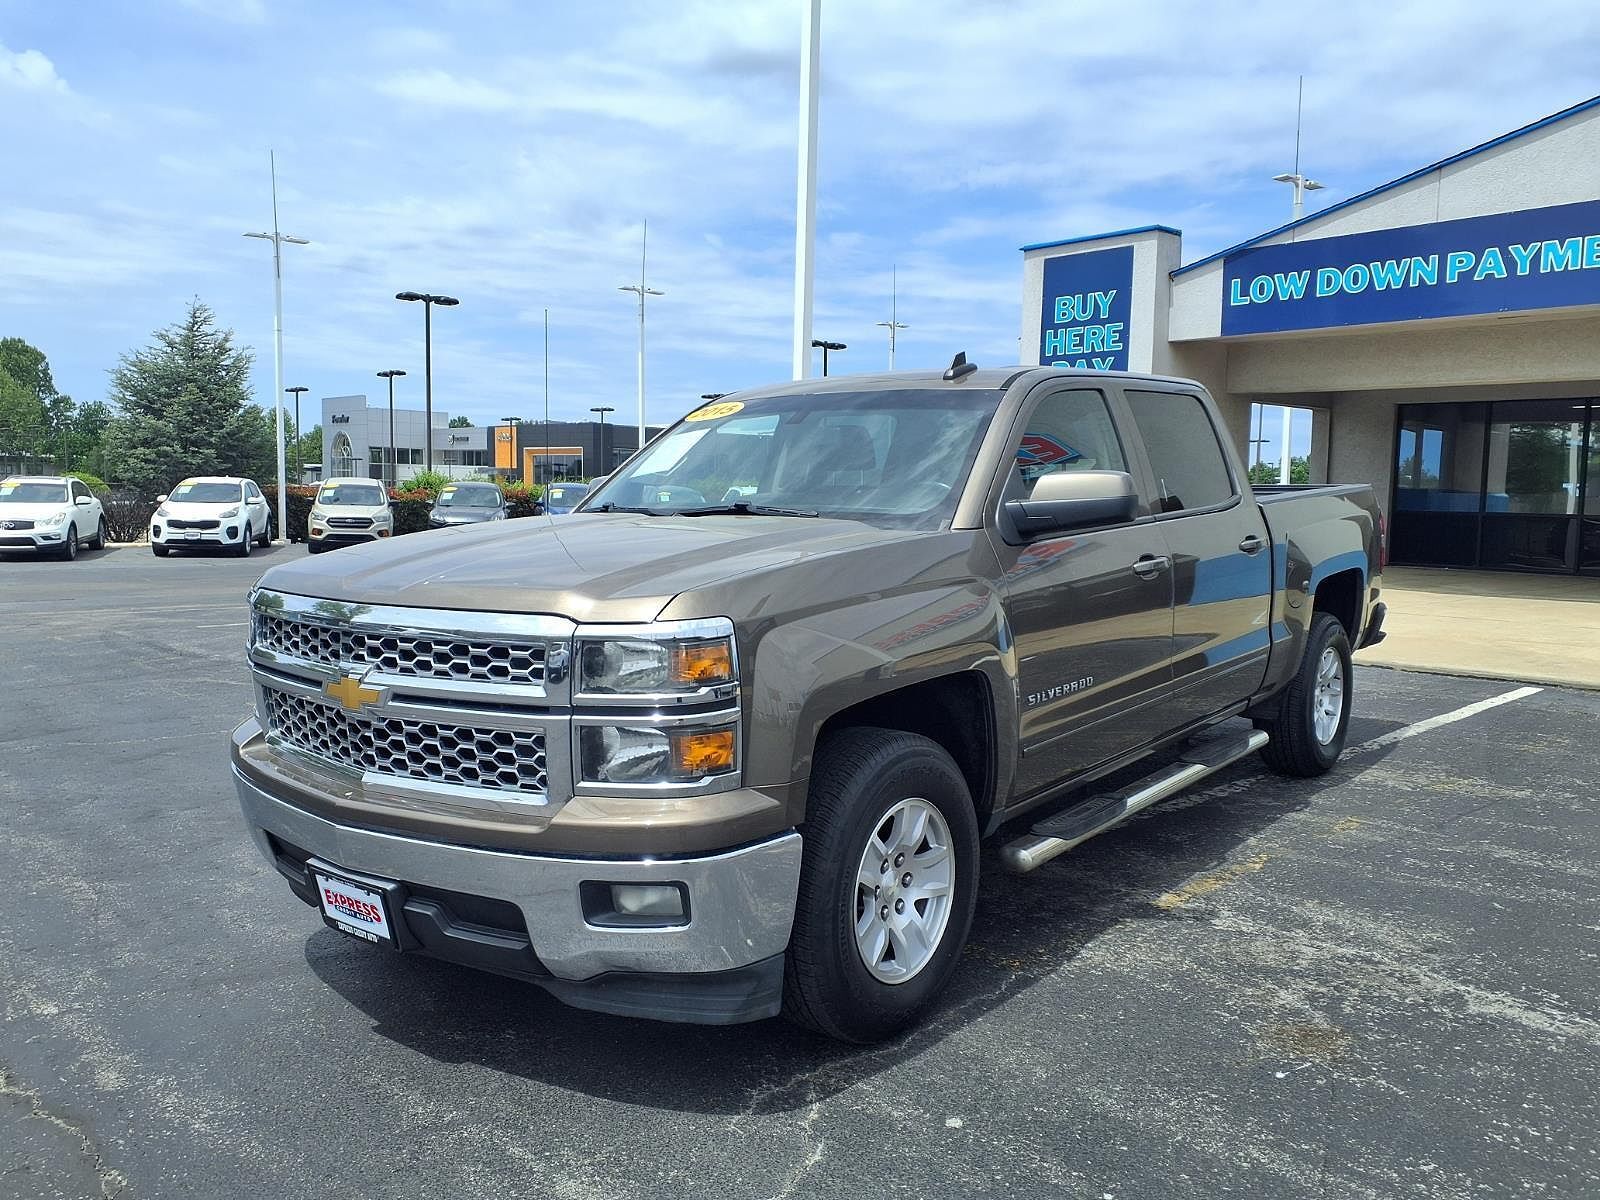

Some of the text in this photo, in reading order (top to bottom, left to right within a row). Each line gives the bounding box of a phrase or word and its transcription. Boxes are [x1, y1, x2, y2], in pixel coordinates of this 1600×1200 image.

[1230, 234, 1600, 306] LOW DOWN PAYME
[1055, 289, 1117, 323] BUY
[1045, 322, 1123, 356] HERE
[1028, 676, 1094, 706] SILVERADO
[324, 888, 382, 923] EXPRESS
